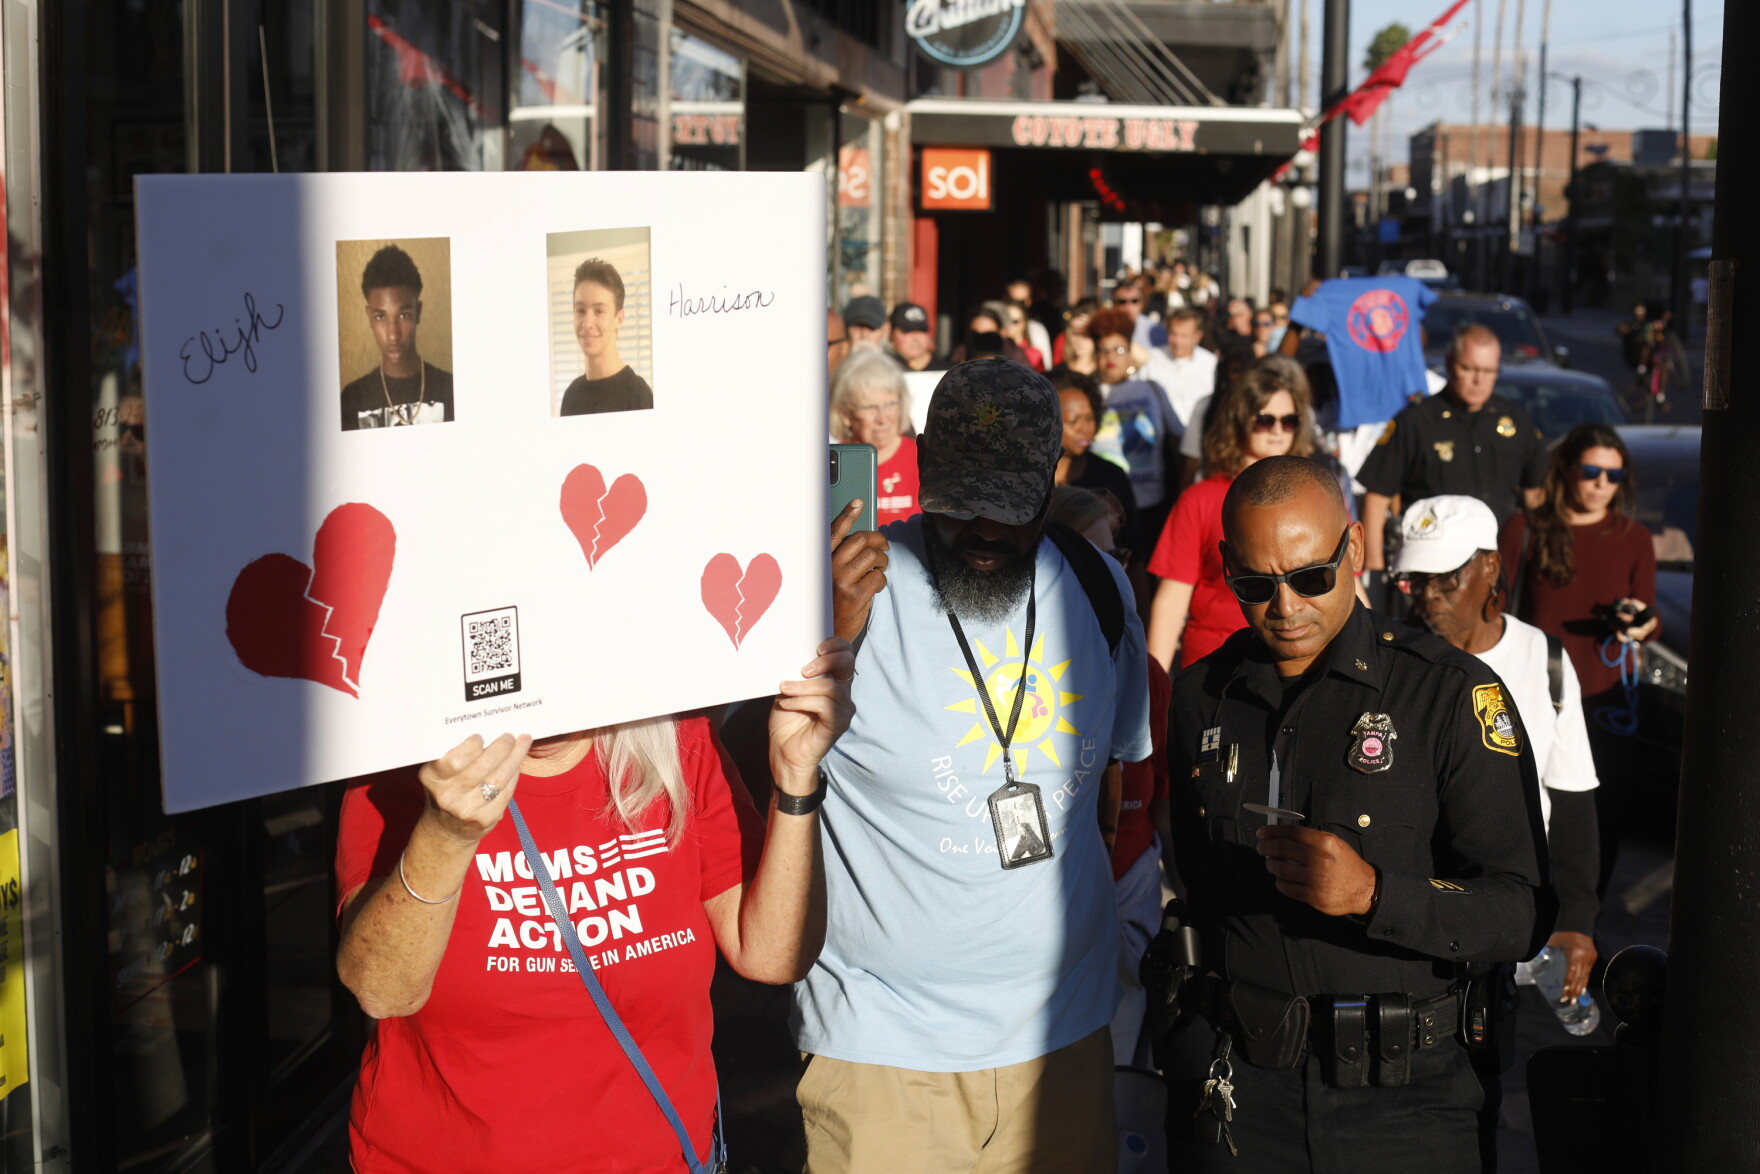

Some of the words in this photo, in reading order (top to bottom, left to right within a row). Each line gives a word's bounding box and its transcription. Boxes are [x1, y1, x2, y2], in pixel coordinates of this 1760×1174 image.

[1012, 115, 1120, 149] COYOTE
[1123, 118, 1200, 151] UGLY
[928, 152, 988, 200] sol
[669, 282, 775, 318] Harrison
[472, 681, 499, 697] SCAN
[500, 678, 515, 690] ME
[445, 711, 483, 725] Everytown
[483, 704, 512, 717] Survivor
[513, 698, 543, 710] Network
[1363, 730, 1383, 738] TAMPA
[931, 755, 969, 804] RISE
[1052, 736, 1096, 811] PEACE
[1119, 799, 1143, 810] ERICA
[939, 836, 969, 854] One
[974, 837, 999, 855] Voi
[487, 903, 644, 952] ACTON
[486, 956, 521, 972] FOR
[525, 957, 556, 973] GUN
[559, 954, 602, 973] SEE
[601, 948, 621, 967] IN
[625, 927, 697, 961] AMERICA
